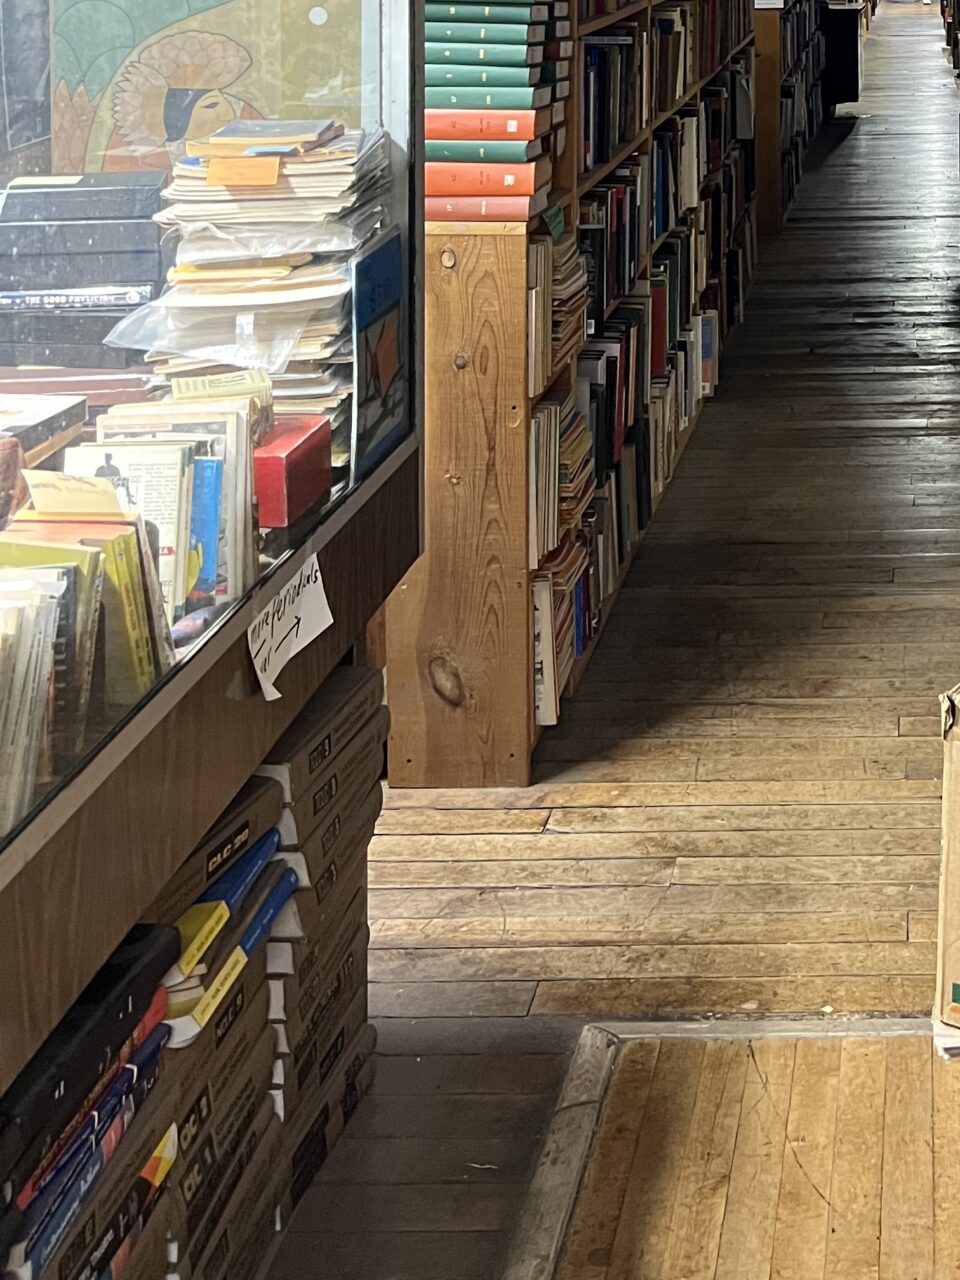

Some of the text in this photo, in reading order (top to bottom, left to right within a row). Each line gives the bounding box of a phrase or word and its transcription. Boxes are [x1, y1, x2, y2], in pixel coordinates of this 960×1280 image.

[25, 295, 114, 304] THE GOOD PHYSICIAN
